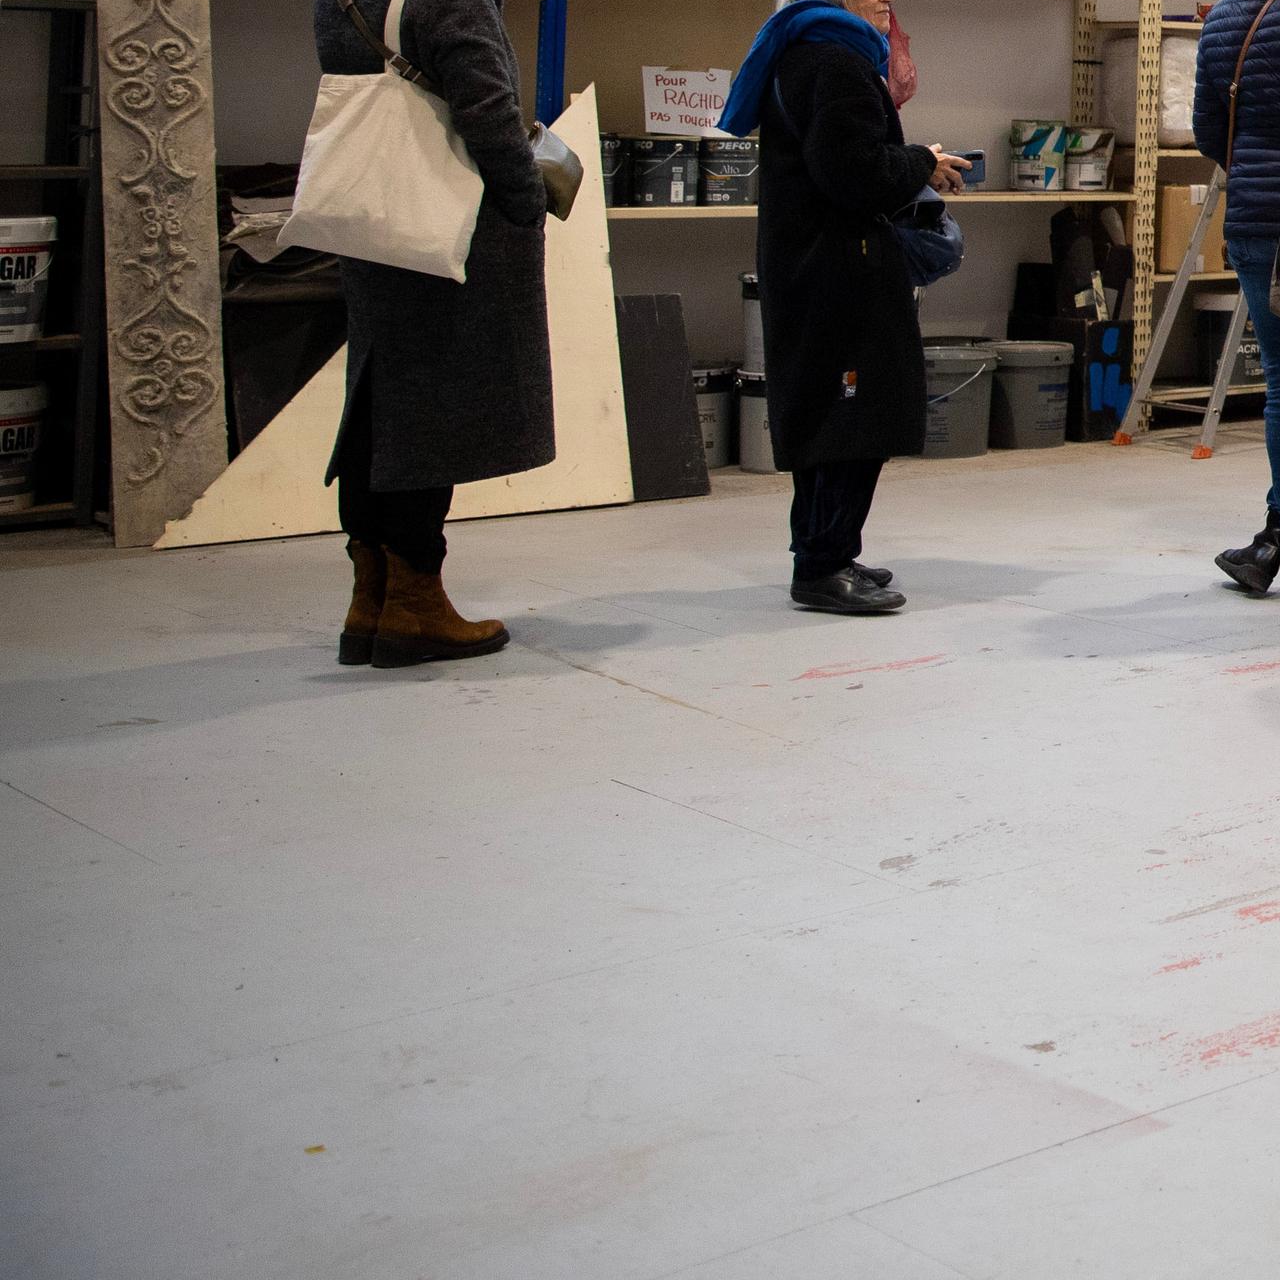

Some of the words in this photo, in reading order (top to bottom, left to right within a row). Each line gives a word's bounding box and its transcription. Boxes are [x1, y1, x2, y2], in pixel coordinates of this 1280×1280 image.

[664, 88, 724, 110] RACHID
[650, 112, 671, 122] PAS
[717, 141, 752, 150] JEFCO
[720, 163, 740, 175] Alto
